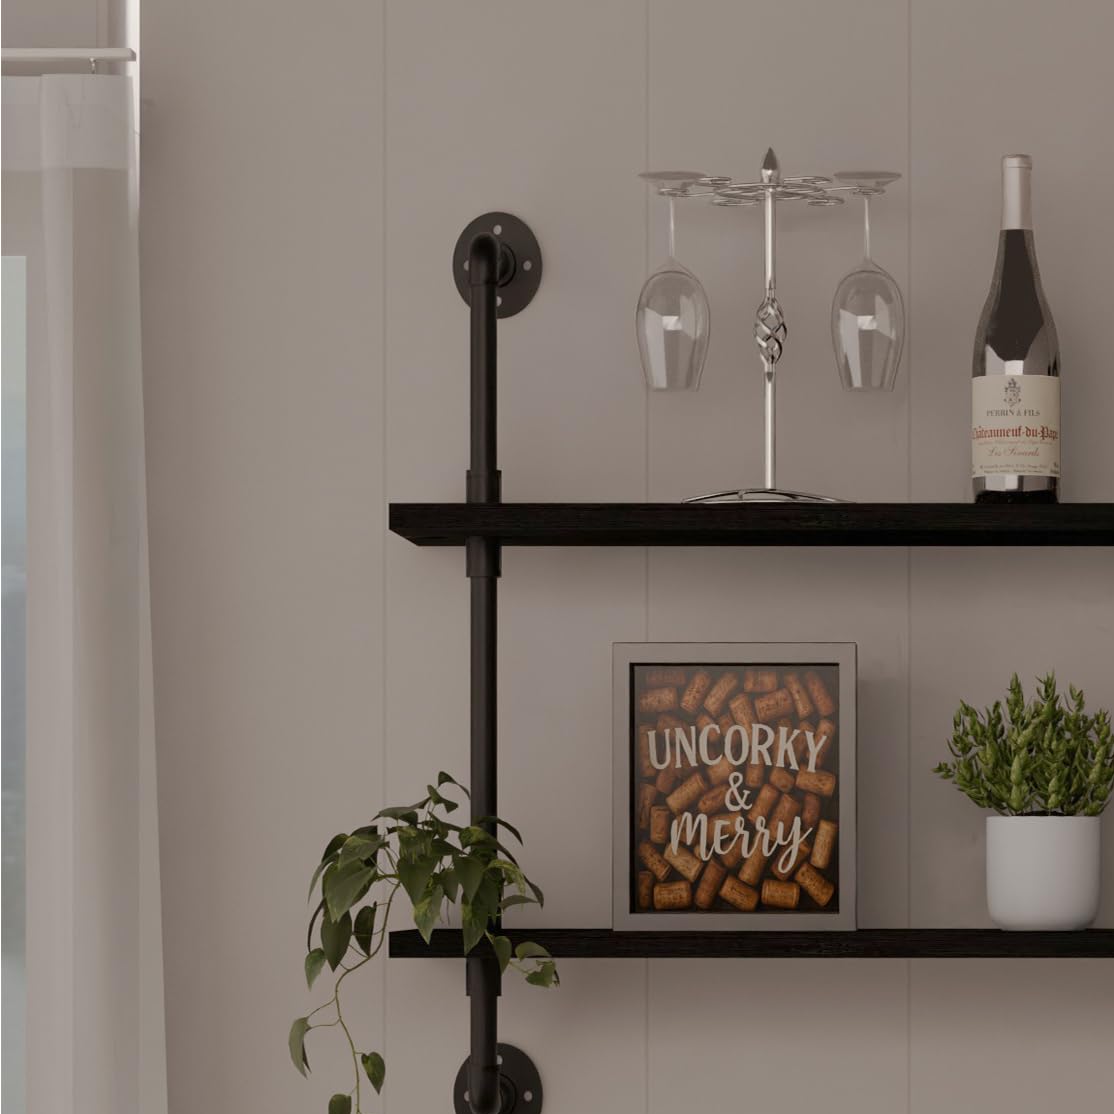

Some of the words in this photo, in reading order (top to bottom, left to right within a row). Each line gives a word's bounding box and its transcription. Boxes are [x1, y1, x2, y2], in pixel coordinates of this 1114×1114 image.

[986, 409, 1015, 417] PERRIN
[1023, 409, 1041, 417] FILS
[647, 723, 828, 773] UNCORKY
[725, 771, 753, 811] &
